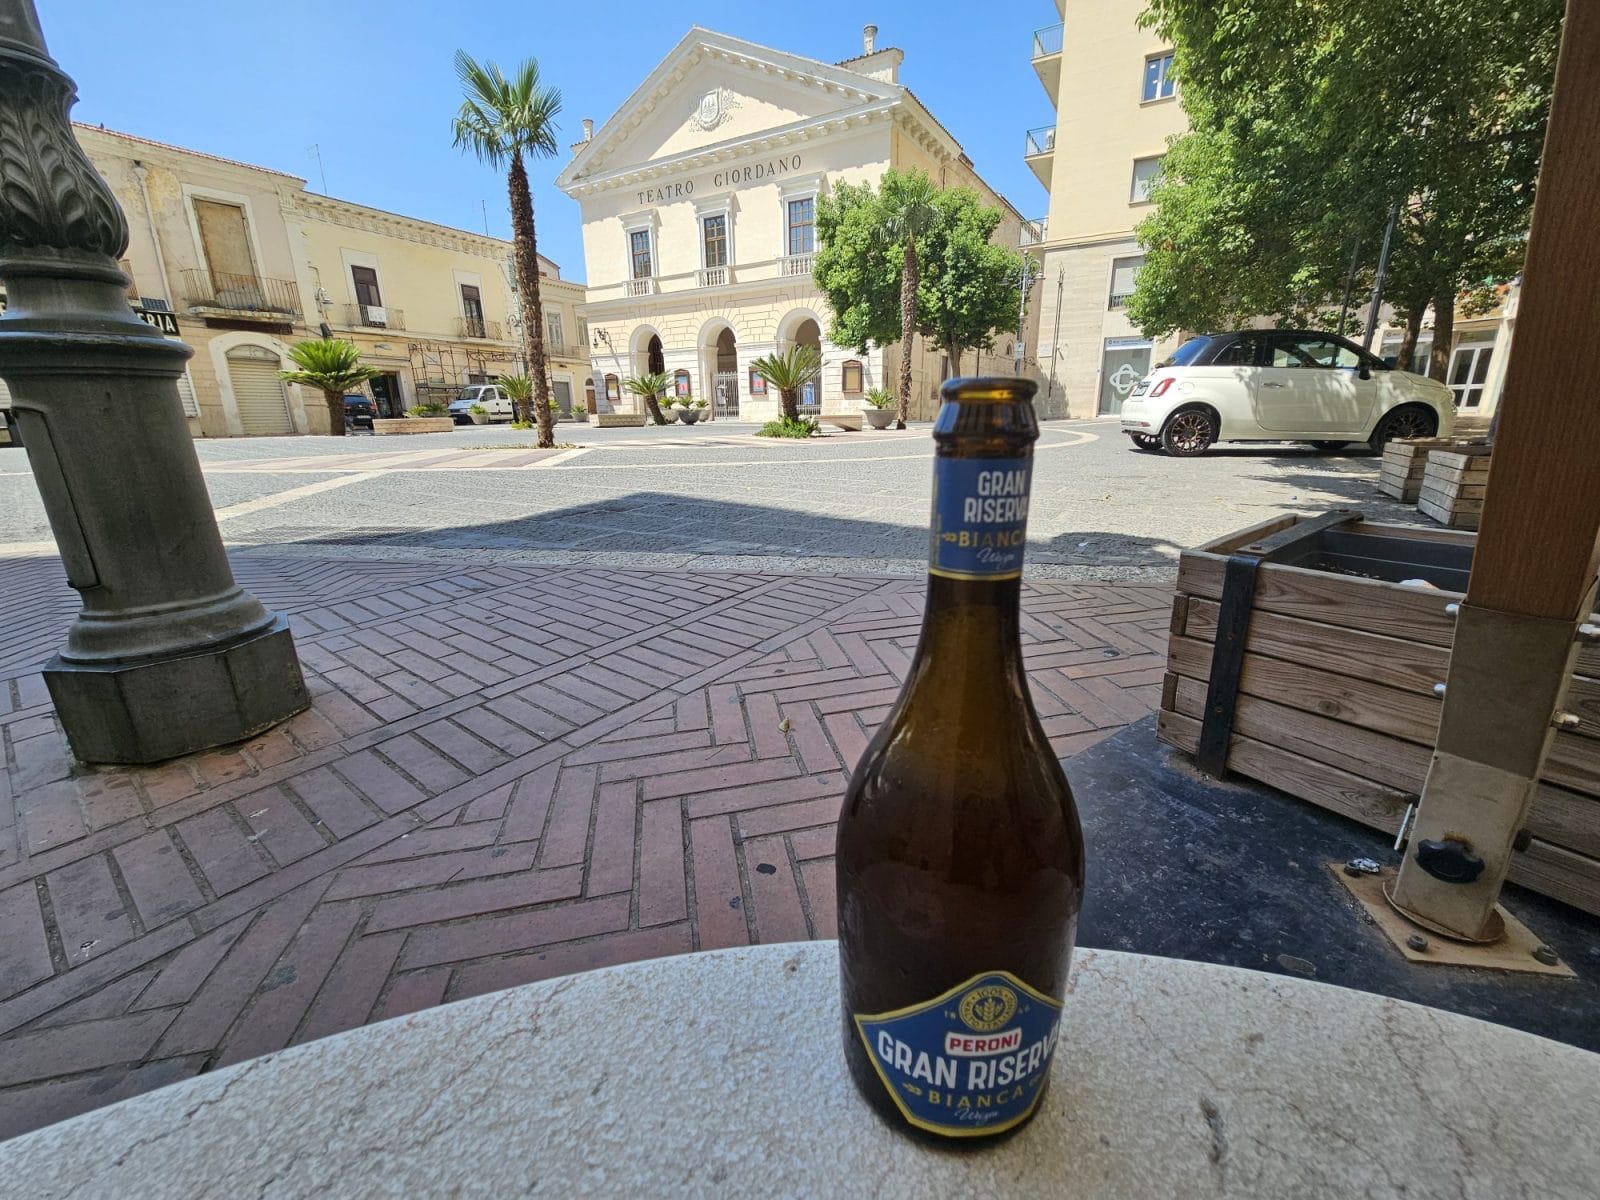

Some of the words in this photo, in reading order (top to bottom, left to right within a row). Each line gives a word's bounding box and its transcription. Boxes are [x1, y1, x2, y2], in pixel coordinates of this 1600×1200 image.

[637, 180, 694, 205] TEATRO
[714, 154, 802, 187] GIORDANO
[978, 470, 1026, 496] GRAN
[958, 530, 1025, 548] BIANC
[949, 1032, 1019, 1053] PERONI
[878, 1030, 957, 1090] GRAN
[928, 1085, 1023, 1109] BIANCA
